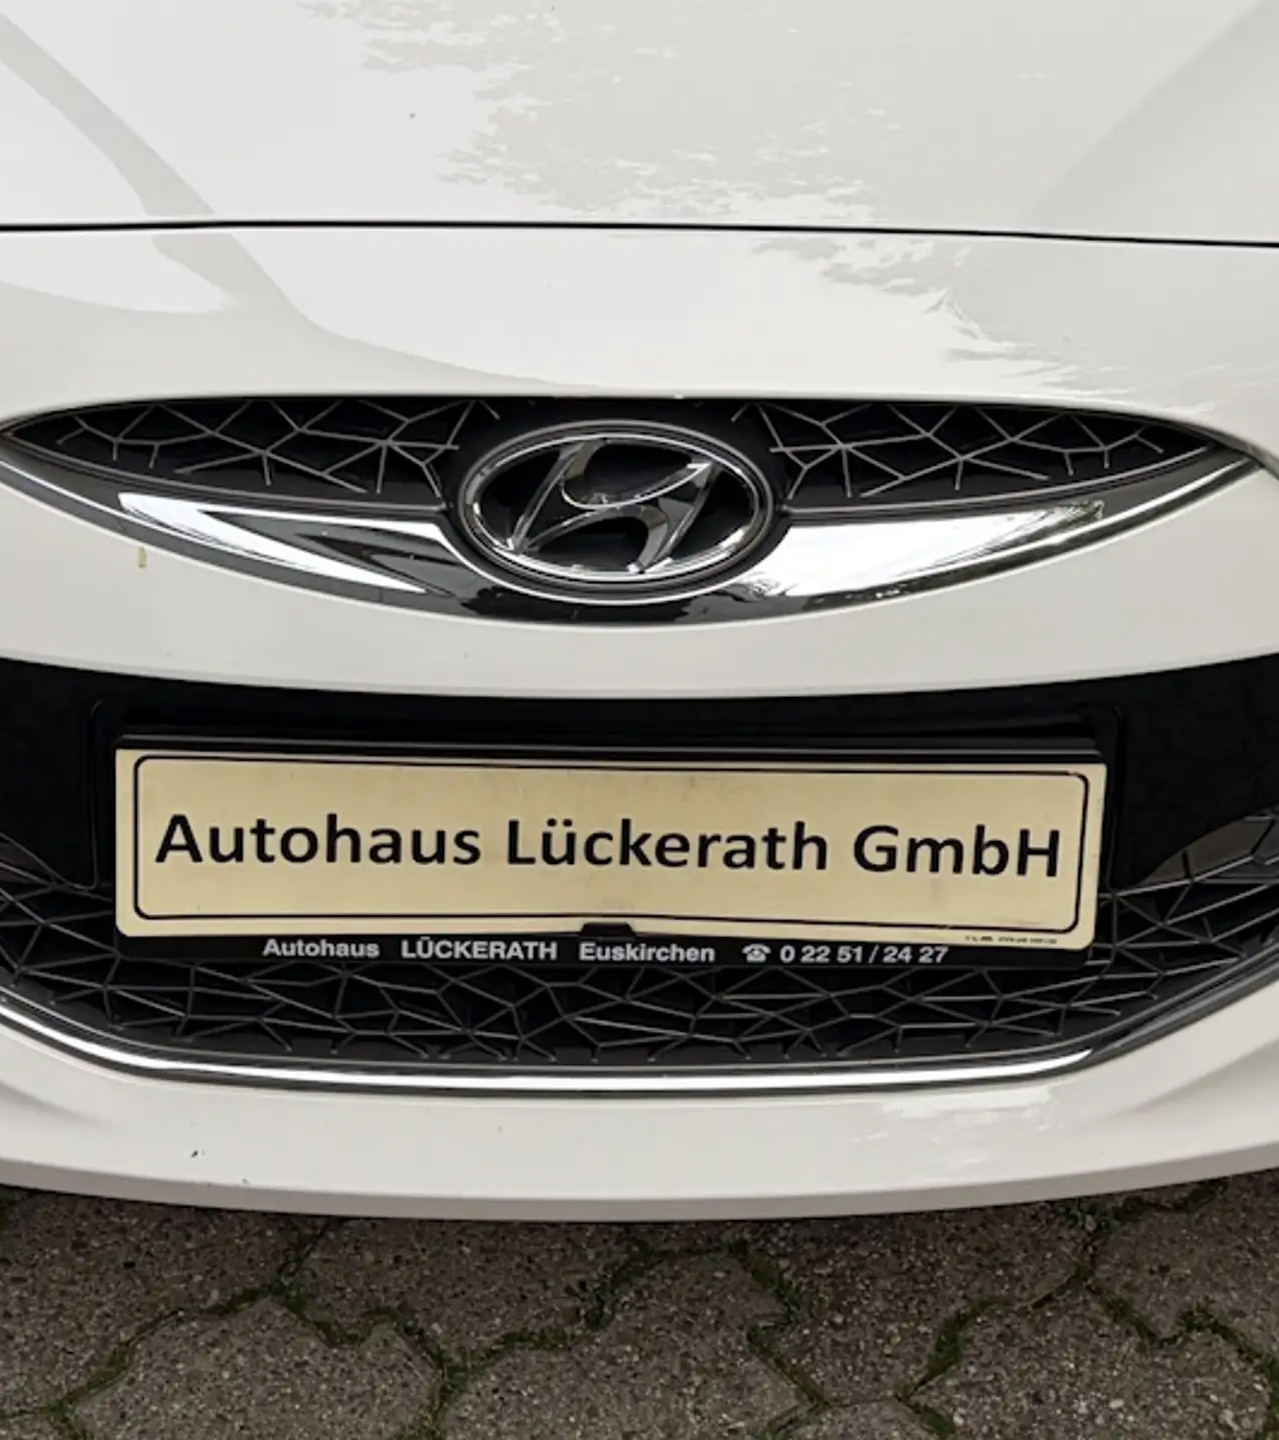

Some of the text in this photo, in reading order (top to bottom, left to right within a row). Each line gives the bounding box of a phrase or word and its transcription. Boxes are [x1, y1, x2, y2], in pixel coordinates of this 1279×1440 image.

[155, 813, 1061, 878] Autohaus Lückerath GmbH
[262, 938, 381, 958] Autohaus
[400, 936, 558, 960] LÜCKERATH
[578, 942, 716, 963] Euskirchen
[779, 945, 795, 963] 0
[800, 945, 831, 963] 22
[836, 945, 863, 963] 51
[882, 946, 913, 963] 24
[919, 946, 949, 964] 27
